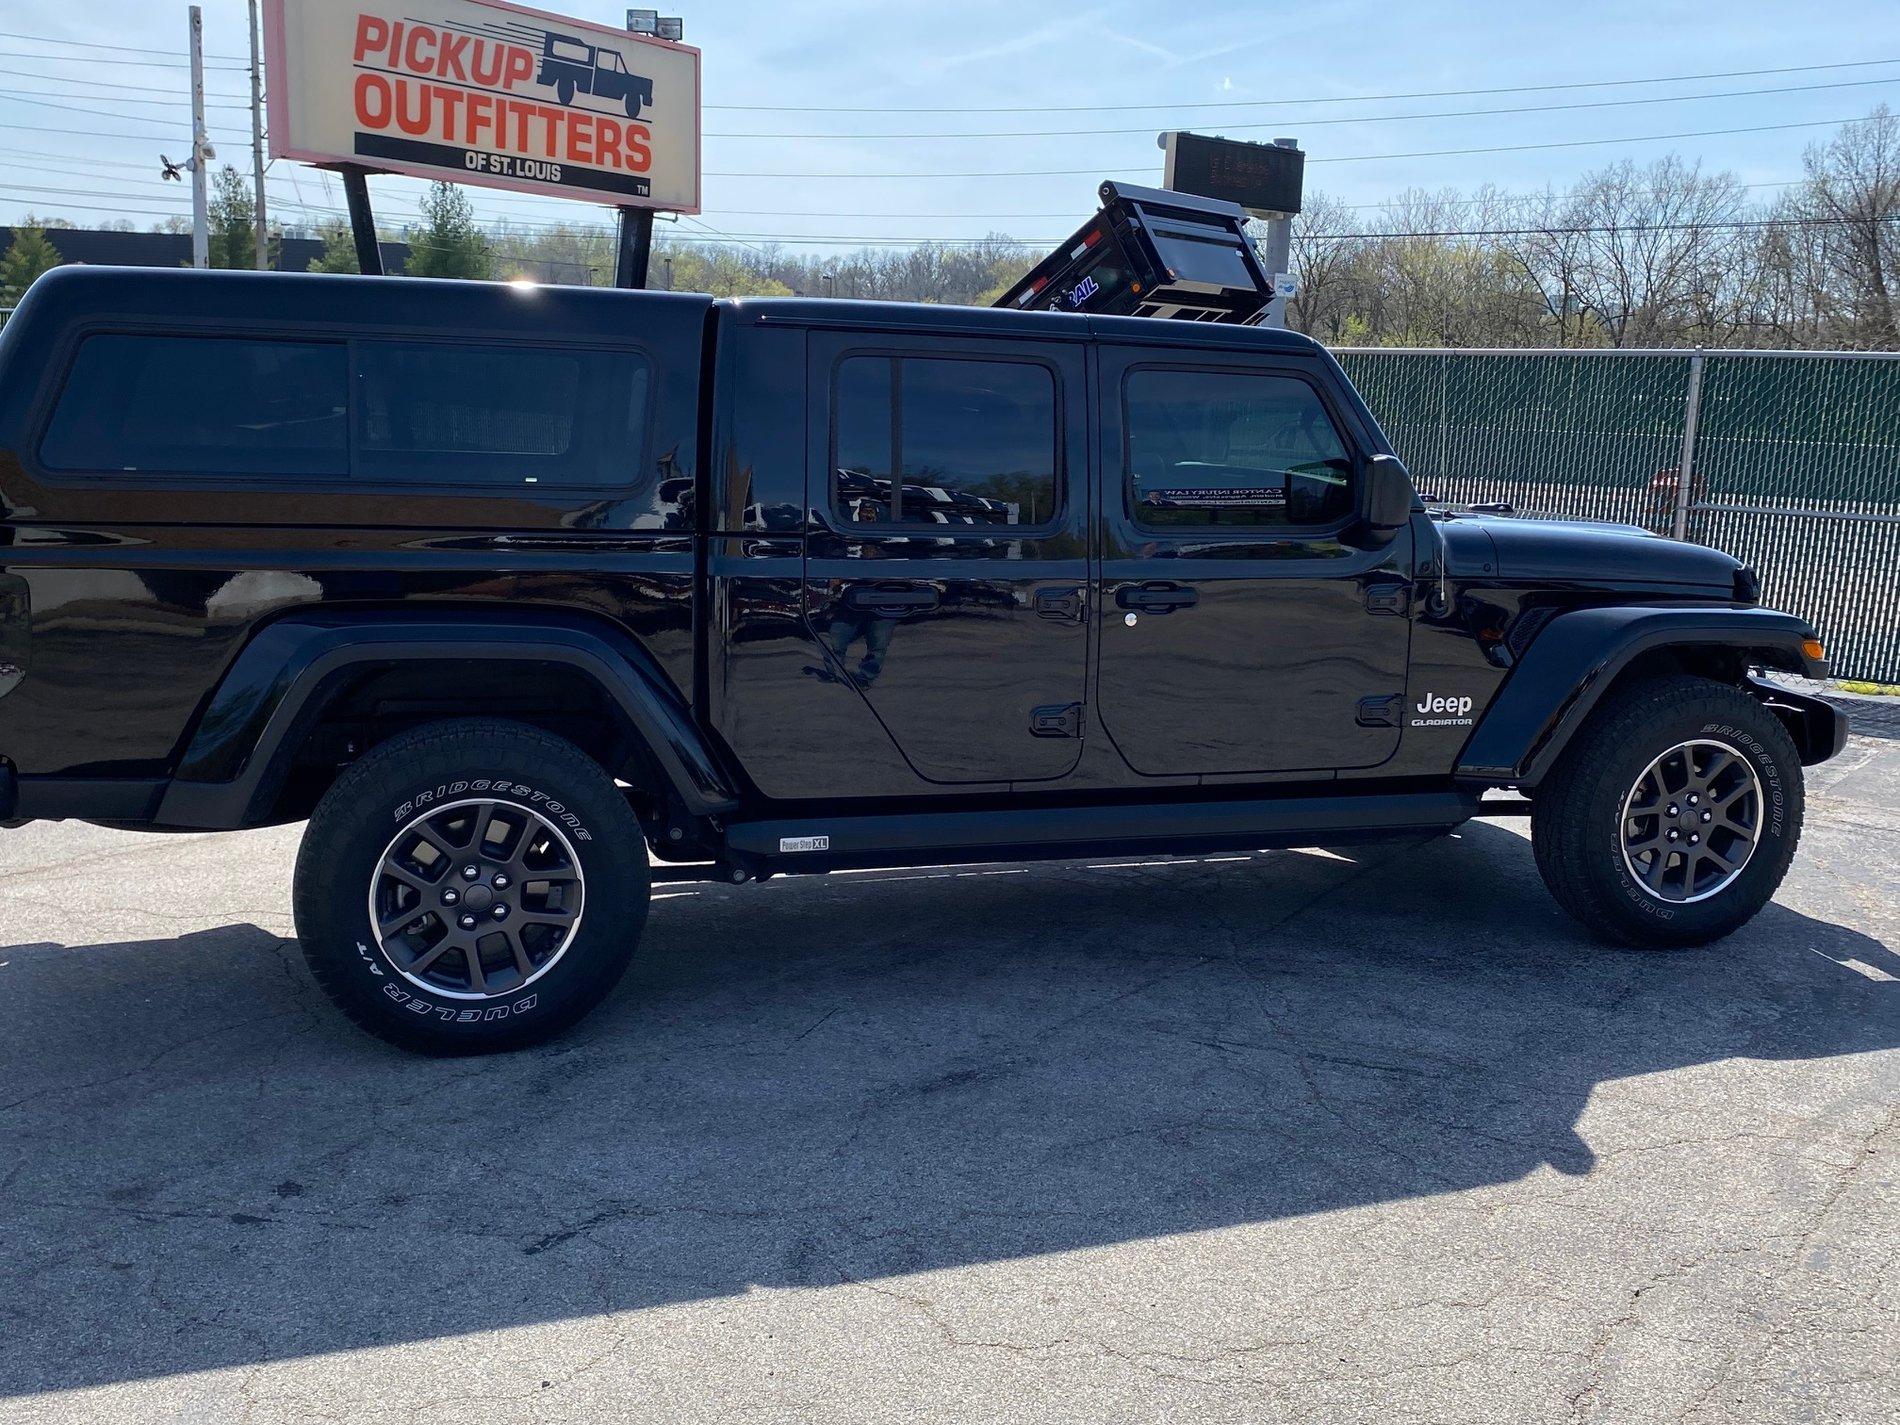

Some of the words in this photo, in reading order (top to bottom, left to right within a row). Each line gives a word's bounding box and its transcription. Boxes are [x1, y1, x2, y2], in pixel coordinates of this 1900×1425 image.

[354, 14, 534, 90] PICKUP
[354, 73, 652, 173] OUTFITTERS
[465, 151, 487, 170] OF
[490, 155, 512, 175] ST.
[516, 158, 562, 182] LOUIS
[637, 184, 649, 195] TM
[1417, 692, 1472, 716] Jeep
[1411, 718, 1473, 726] GLADIATOR
[1700, 723, 1784, 837] BRIDGESTONE
[394, 779, 592, 842] BRIDGESTONE
[813, 839, 826, 848] XL
[356, 942, 384, 976] A/T
[383, 982, 538, 1022] DUELER
